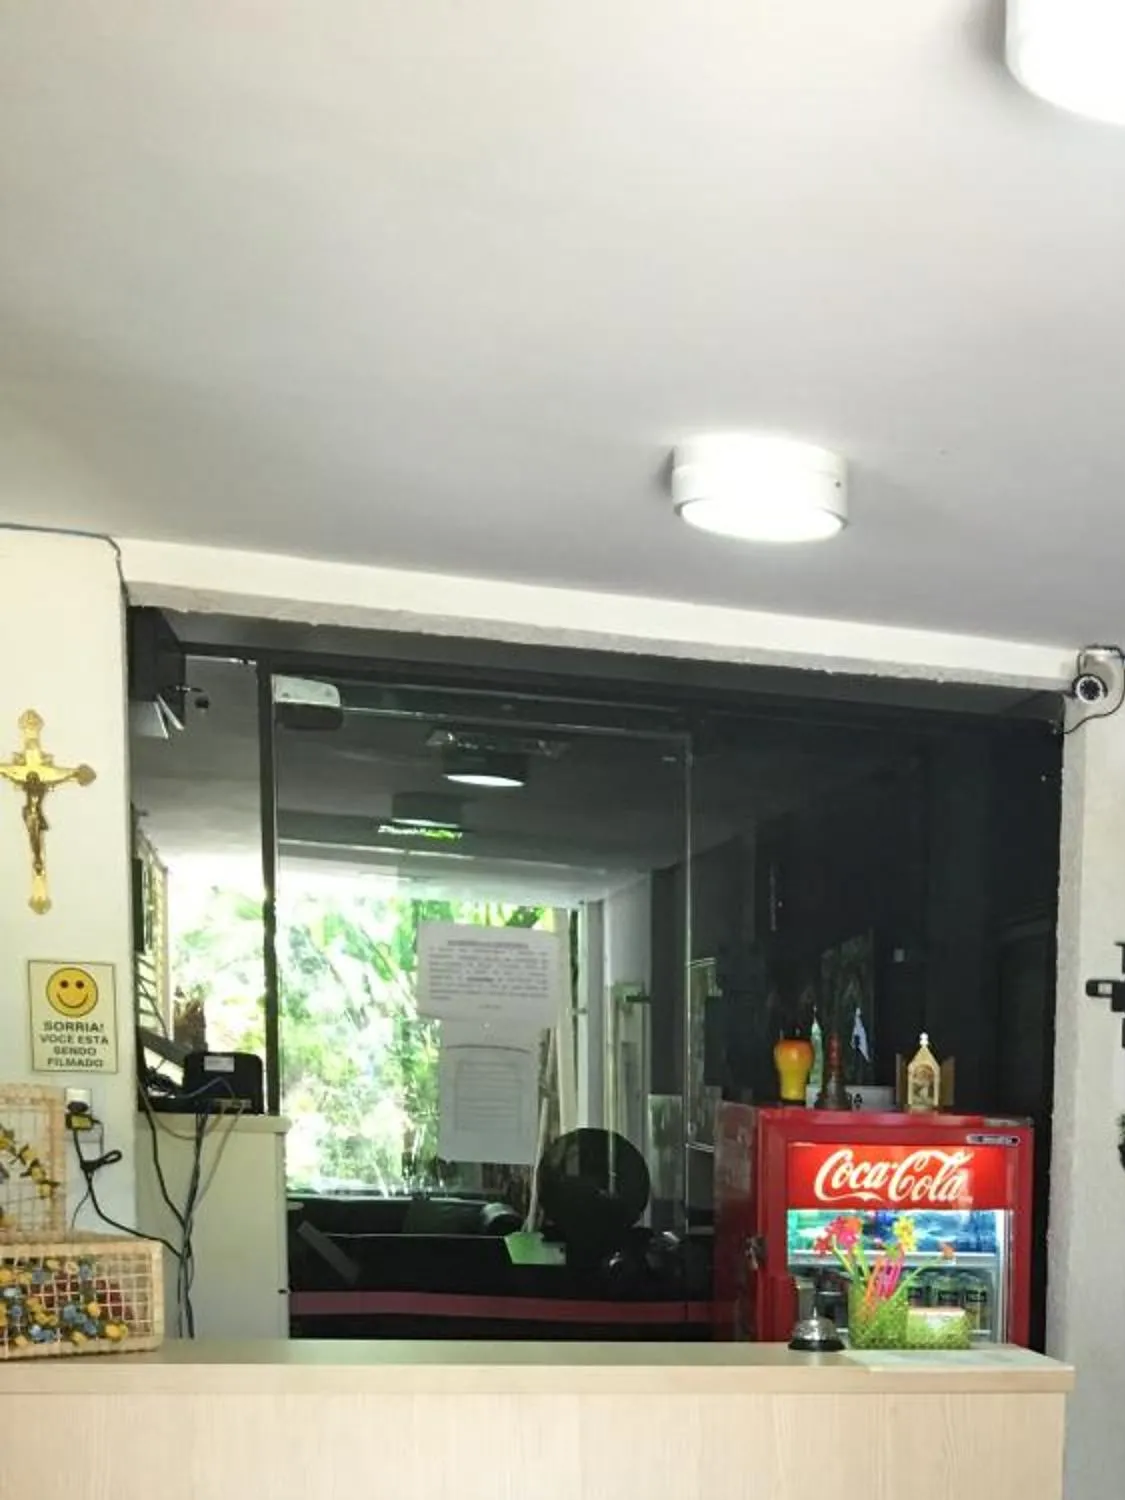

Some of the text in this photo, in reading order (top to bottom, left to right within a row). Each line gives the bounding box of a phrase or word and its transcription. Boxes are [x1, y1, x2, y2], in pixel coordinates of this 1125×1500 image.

[43, 1021, 105, 1033] SORRIA!
[53, 1045, 97, 1056] SENDO
[47, 1057, 104, 1068] FILMADO
[814, 1149, 974, 1202] Coca-Cola
